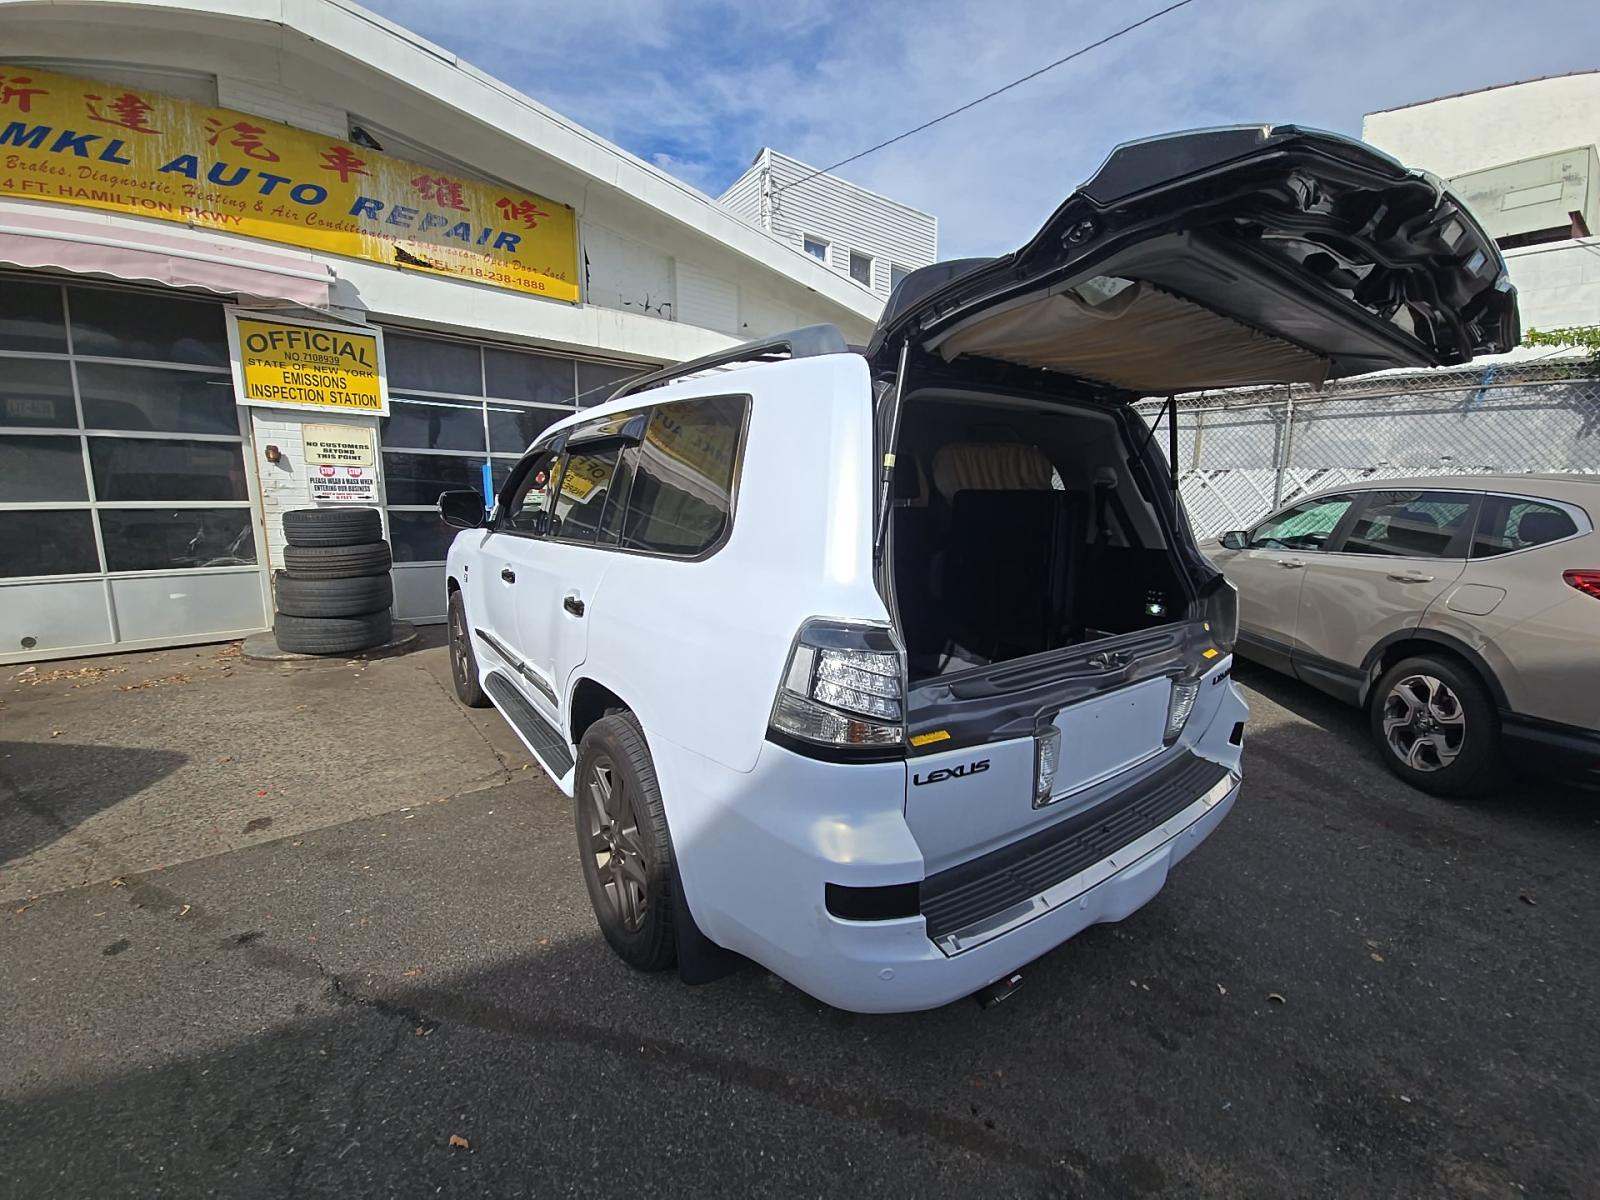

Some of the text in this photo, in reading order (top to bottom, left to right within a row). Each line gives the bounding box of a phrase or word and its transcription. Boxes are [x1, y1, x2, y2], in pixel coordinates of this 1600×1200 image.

[0, 120, 522, 253] MKL AUTO REPAIR
[182, 183, 247, 212] Heating
[253, 200, 264, 213] &
[270, 205, 299, 221] Air
[22, 180, 50, 194] FT.
[59, 184, 172, 213] HAMILTON
[180, 205, 242, 226] PKWY
[246, 329, 373, 368] OFFICIAL
[248, 358, 374, 379] STATE OF NEW YORK
[283, 371, 347, 390] EMISSIONS
[251, 383, 378, 407] INSPECTION STATION
[913, 759, 990, 786] LEXUS
